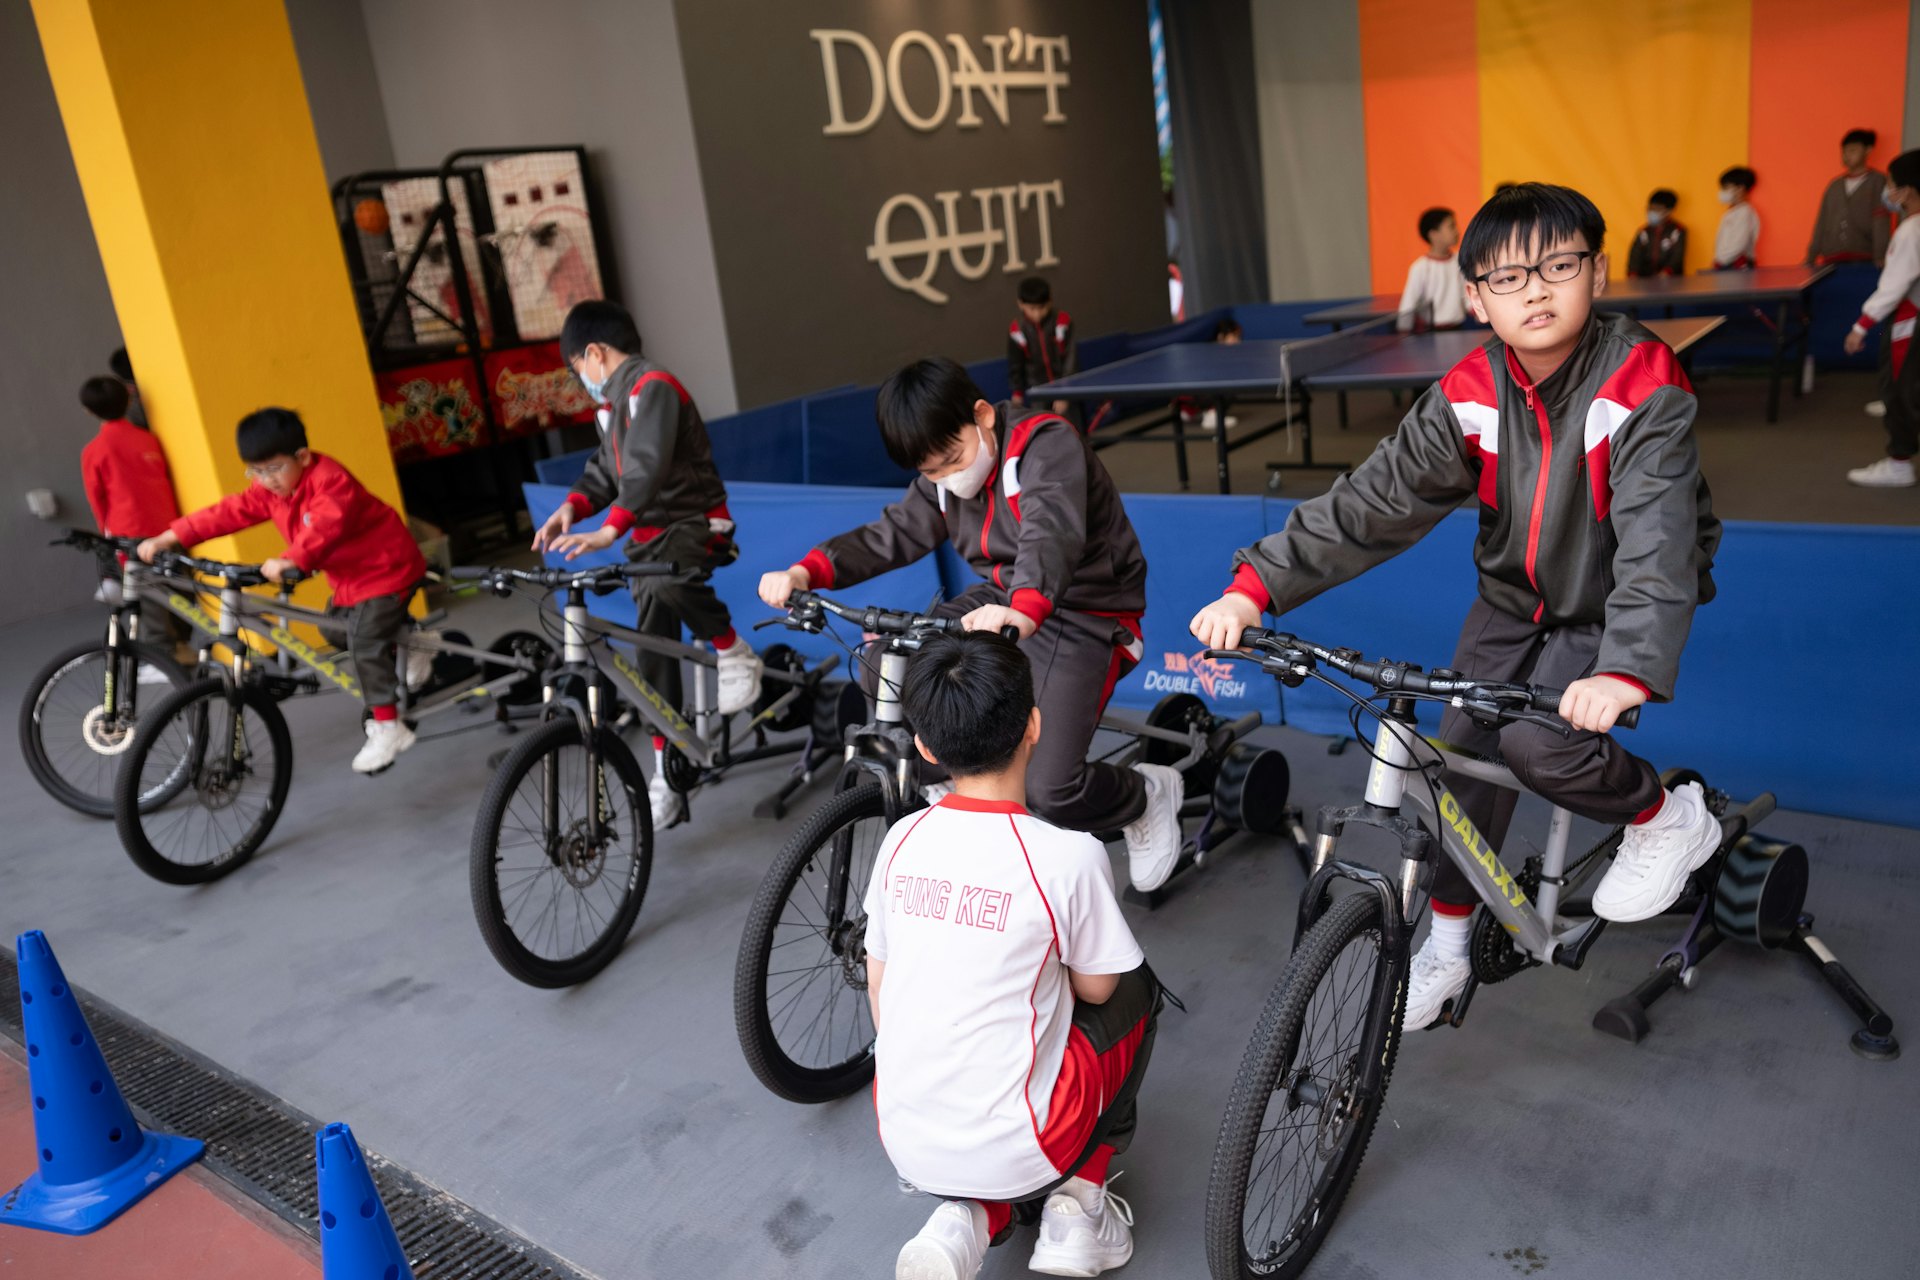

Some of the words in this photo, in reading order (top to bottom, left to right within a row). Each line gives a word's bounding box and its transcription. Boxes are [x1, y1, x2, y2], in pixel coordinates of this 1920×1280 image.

[809, 26, 1071, 136] DON'T
[866, 179, 1065, 304] QUIT
[1143, 669, 1200, 694] DOUBLE
[1213, 680, 1247, 699] FISH
[892, 875, 953, 921] FUNG
[955, 885, 1013, 932] KEI
[1438, 790, 1528, 908] GALAXY
